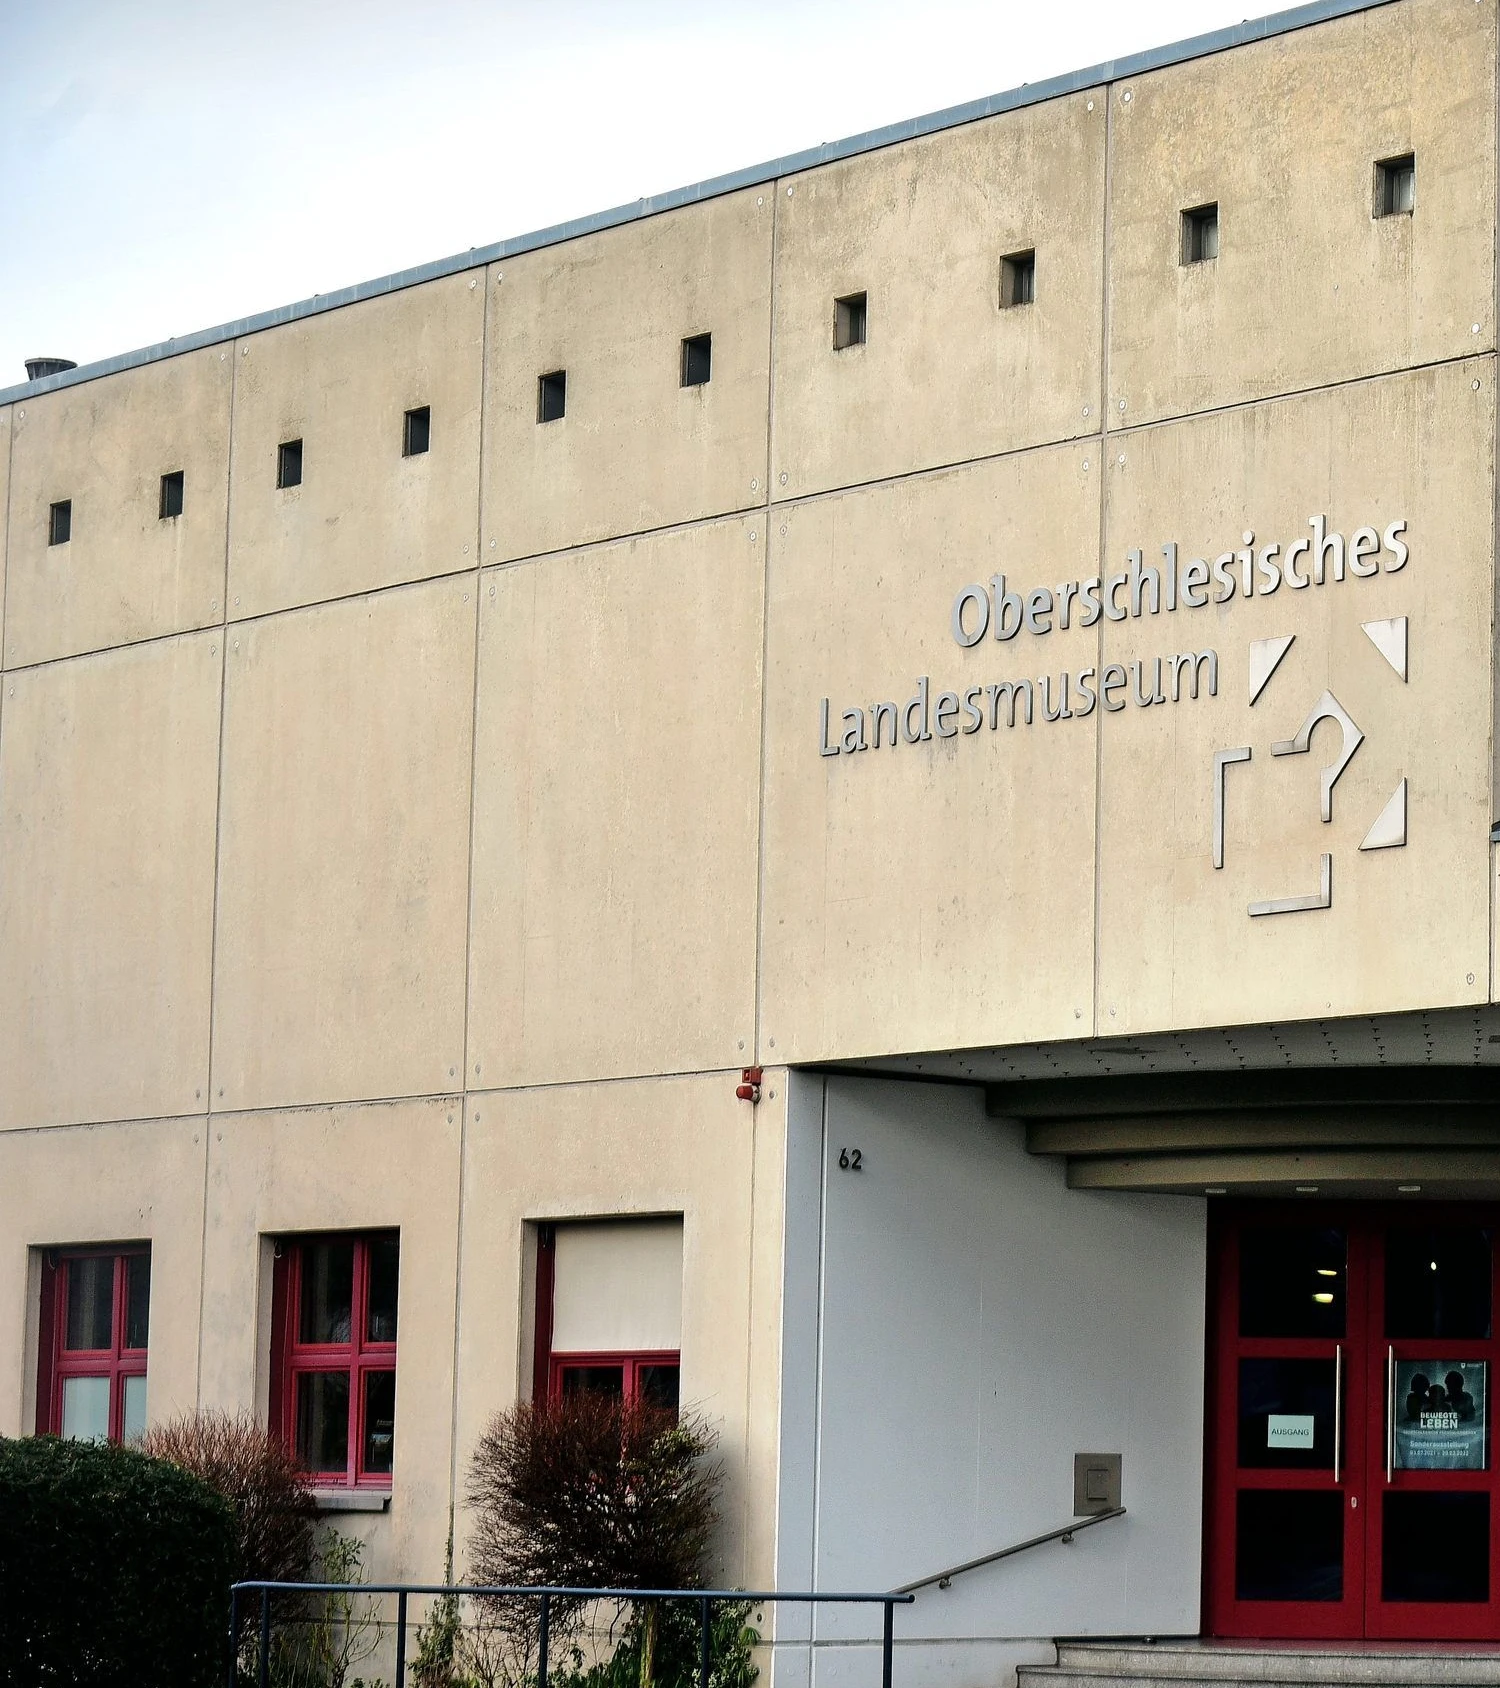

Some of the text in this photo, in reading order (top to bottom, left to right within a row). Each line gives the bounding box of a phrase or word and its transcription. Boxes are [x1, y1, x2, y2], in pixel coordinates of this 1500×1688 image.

[951, 514, 1409, 647] Oberschlesisches
[819, 648, 1218, 757] Landesmuseum
[839, 1147, 862, 1170] 62
[1271, 1428, 1310, 1436] AUSGANG
[1420, 1419, 1458, 1429] LEBEN
